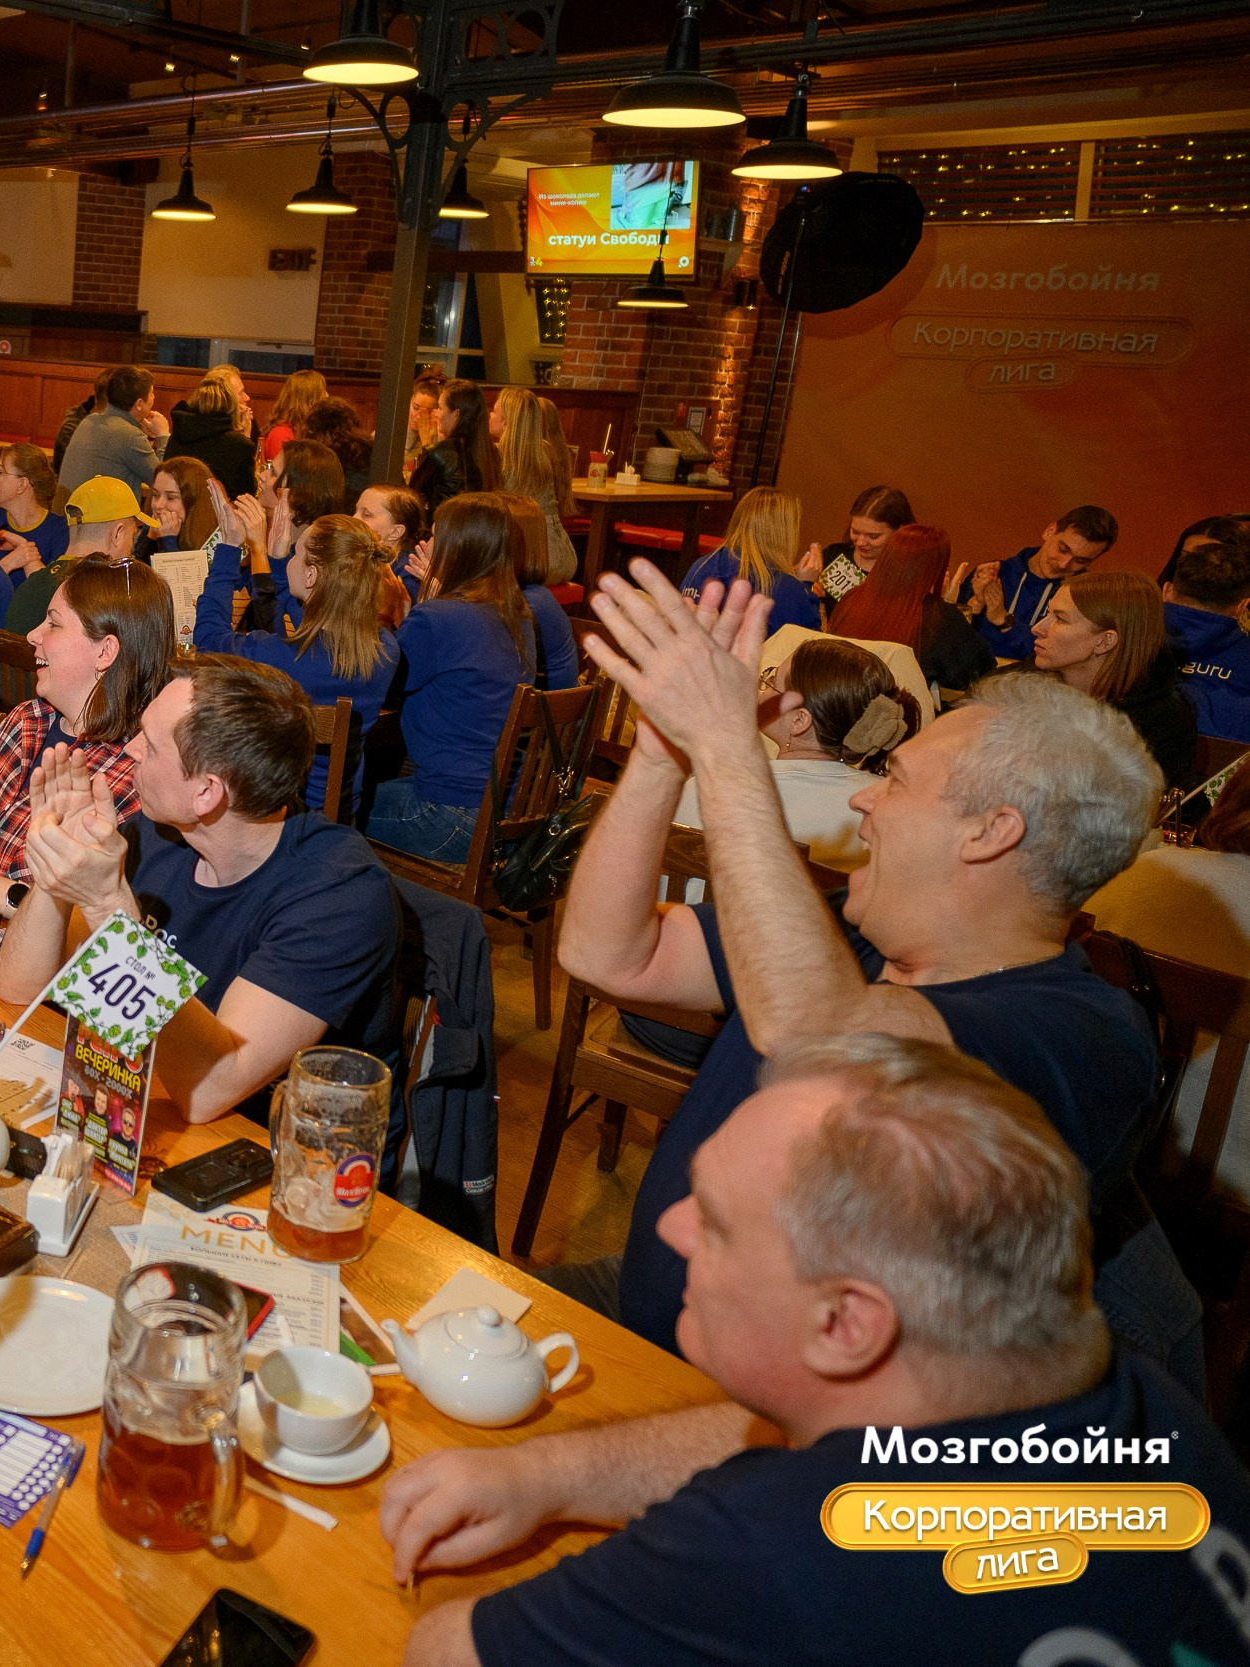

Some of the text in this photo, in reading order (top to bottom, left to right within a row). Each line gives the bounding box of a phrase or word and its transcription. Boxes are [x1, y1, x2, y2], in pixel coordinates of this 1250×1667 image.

[548, 233, 597, 248] статуи
[936, 263, 1161, 292] Мозгобойня
[913, 321, 1159, 354] Корпоративная
[988, 361, 1056, 384] лига
[829, 570, 852, 592] 201
[88, 963, 156, 1020] 405
[75, 1043, 141, 1094] ВЕЧЕРИНКА
